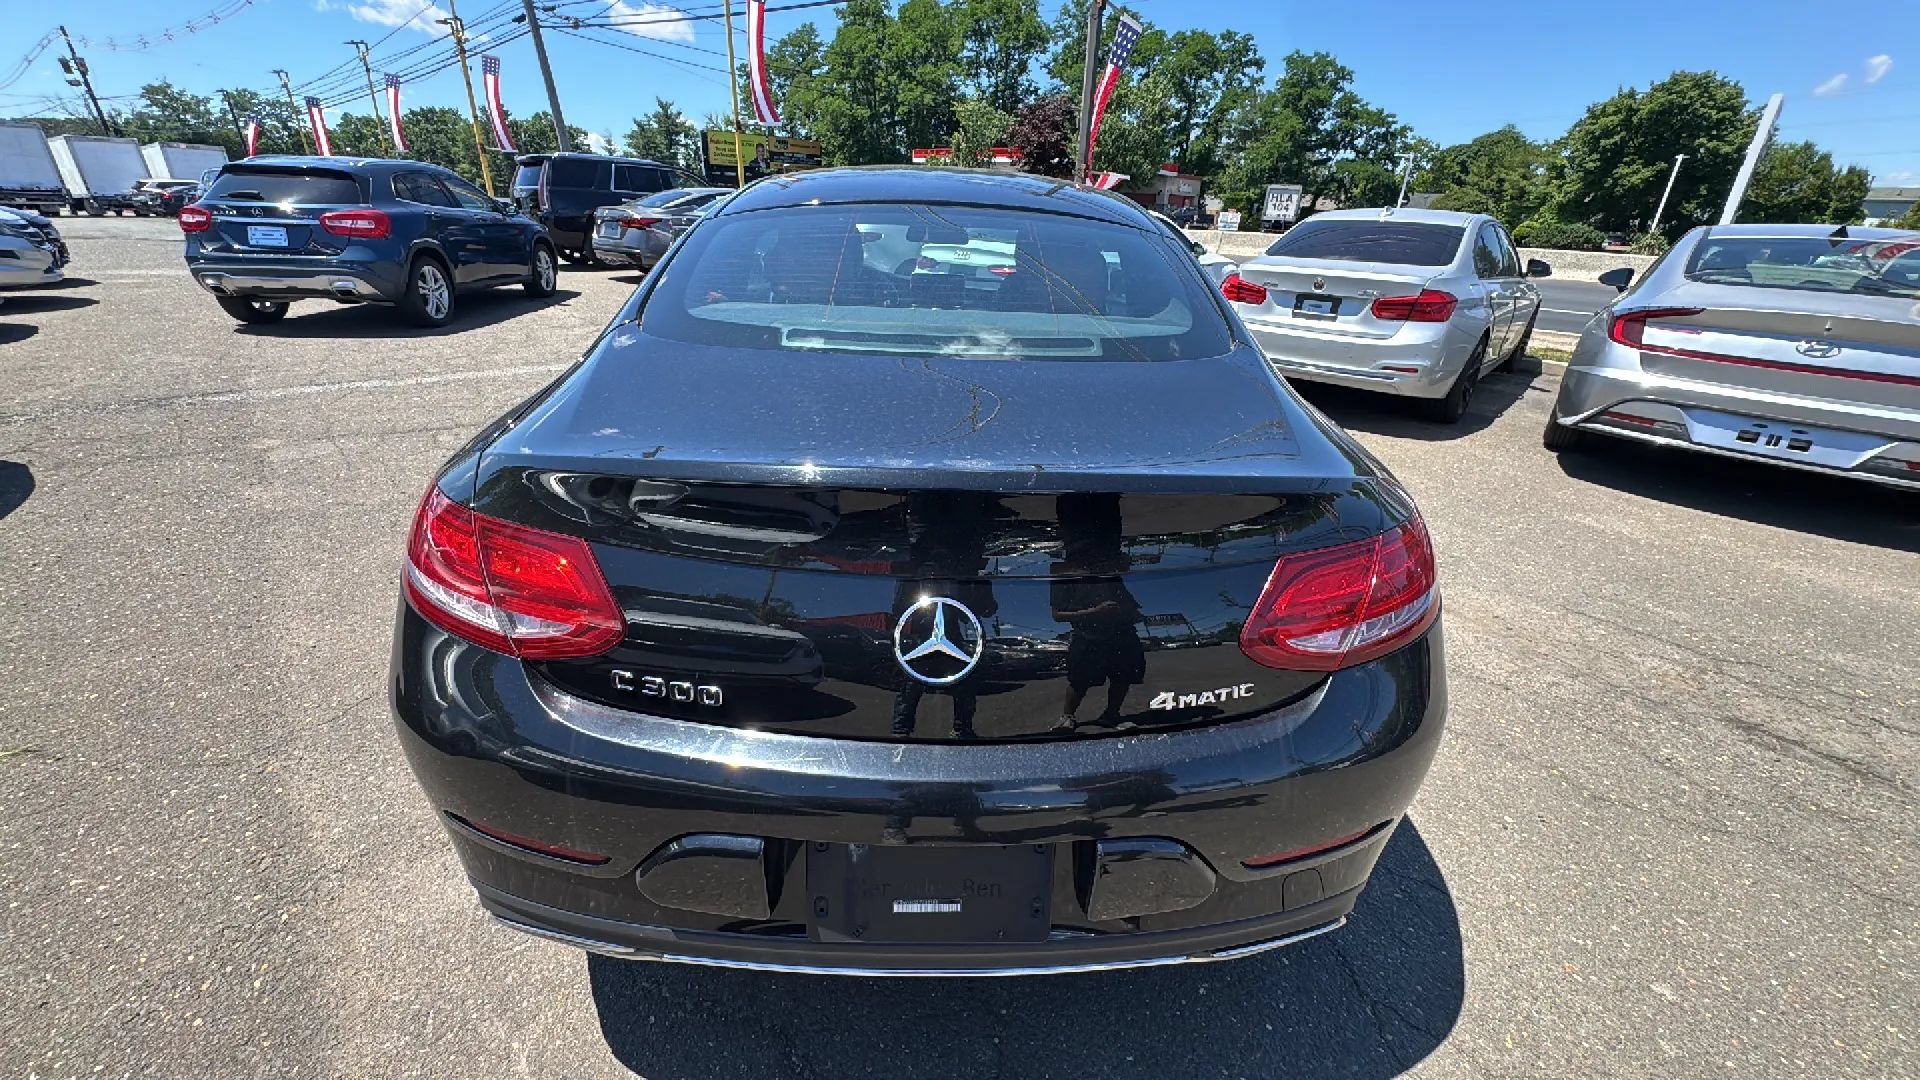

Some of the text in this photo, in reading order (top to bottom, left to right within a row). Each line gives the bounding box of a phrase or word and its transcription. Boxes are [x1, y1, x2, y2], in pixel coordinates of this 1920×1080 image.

[611, 669, 723, 706] C 300
[1149, 683, 1255, 711] 4MATIC
